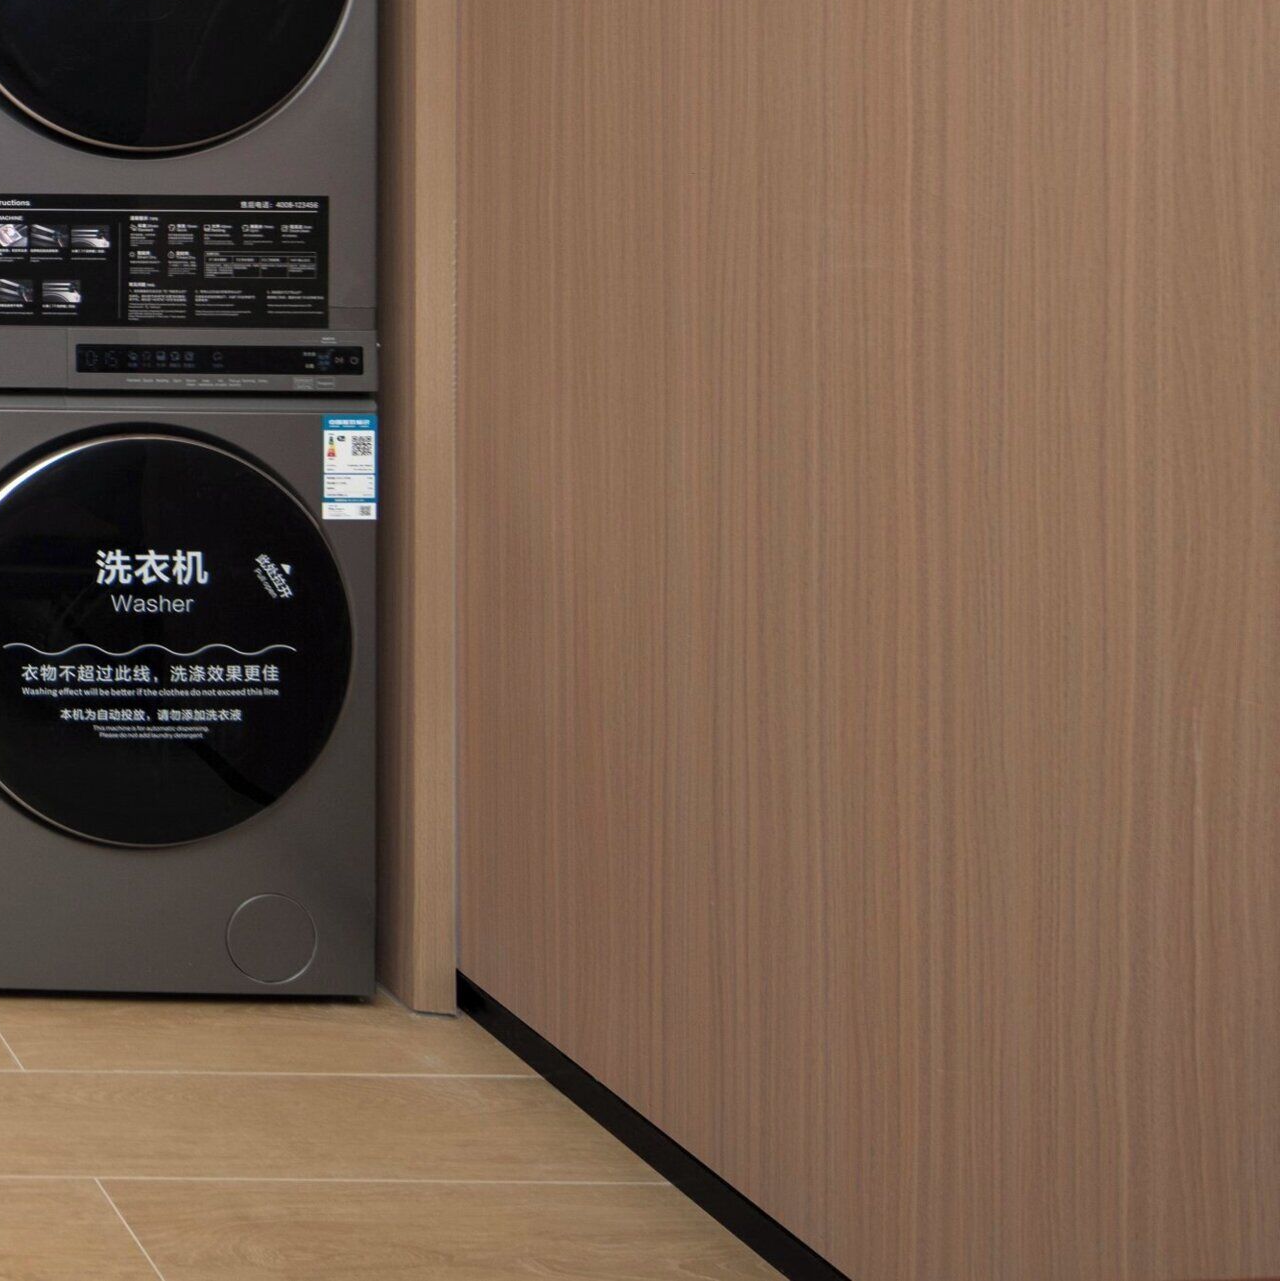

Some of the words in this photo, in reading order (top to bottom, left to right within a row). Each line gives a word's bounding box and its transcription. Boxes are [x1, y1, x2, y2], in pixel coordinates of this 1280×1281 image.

[96, 549, 208, 585] 洗衣机
[111, 595, 194, 612] Washer
[22, 664, 279, 682] 衣物不超过此线，洗涤效果更佳
